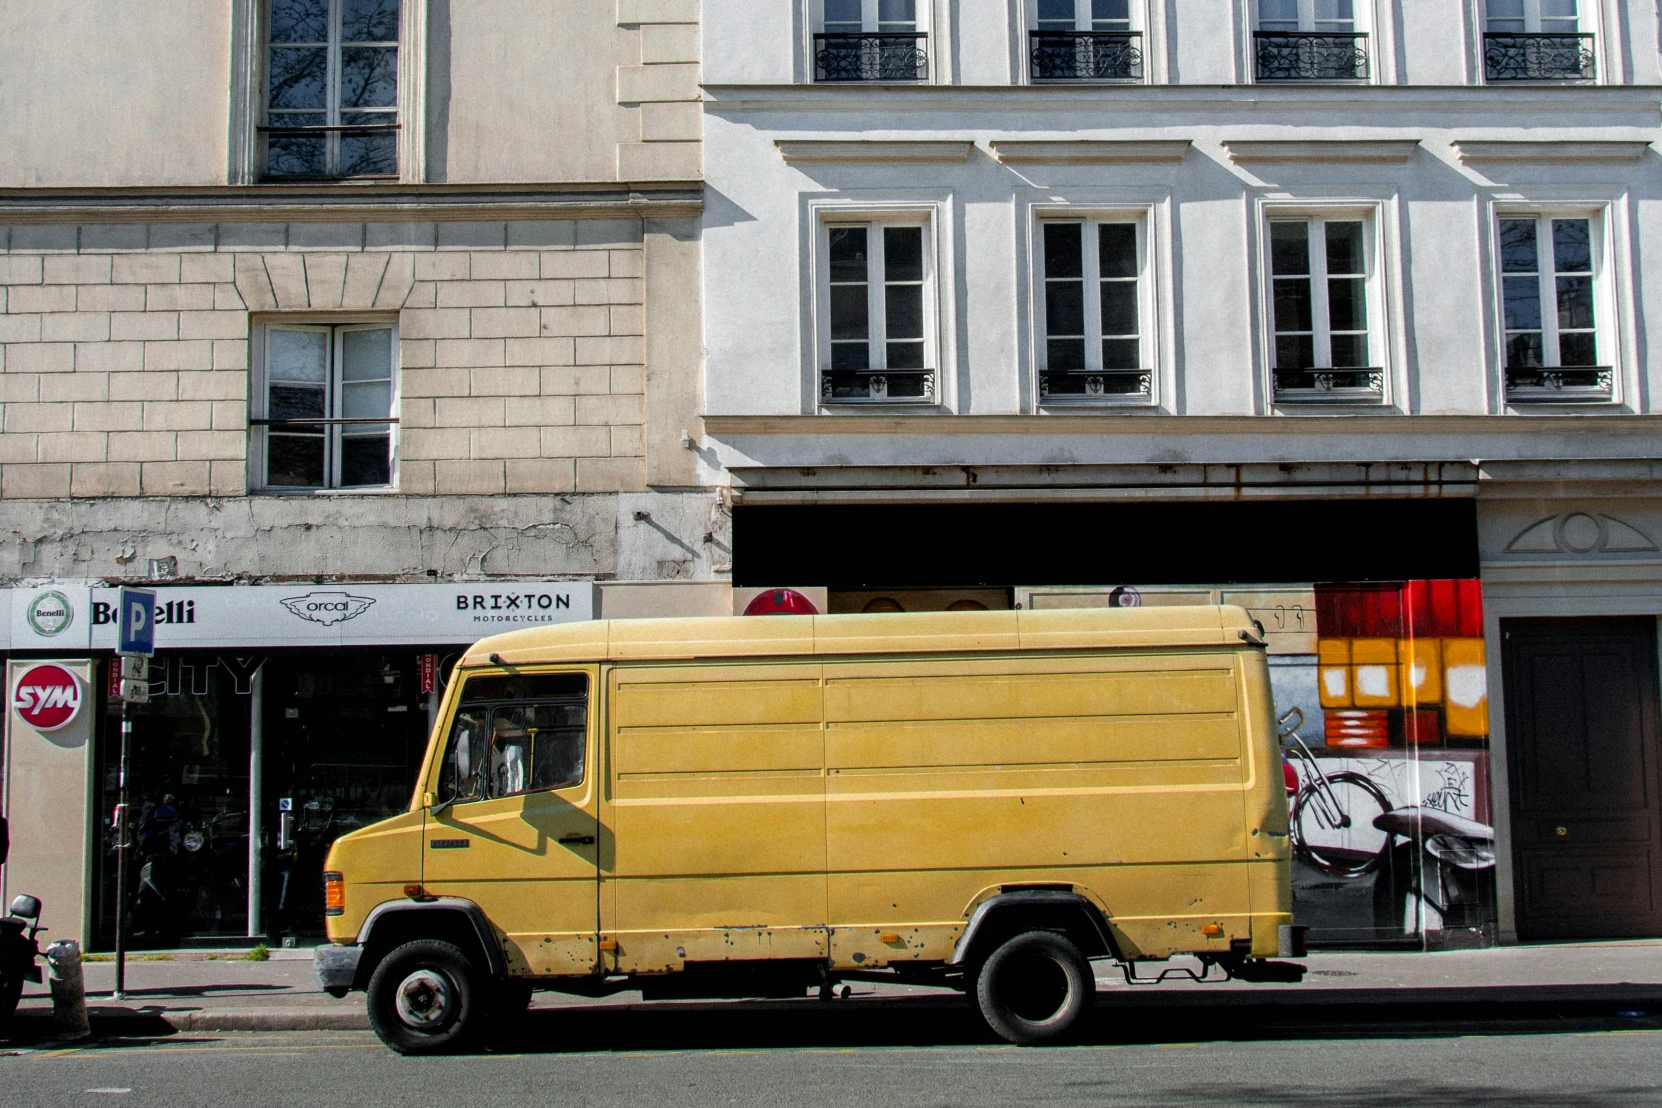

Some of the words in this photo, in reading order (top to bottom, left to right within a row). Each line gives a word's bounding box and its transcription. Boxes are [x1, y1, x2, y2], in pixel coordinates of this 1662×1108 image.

[306, 601, 349, 612] orcal
[456, 594, 570, 610] BRIXTON
[36, 609, 65, 617] Benelli
[473, 615, 553, 623] MOTORCYCLES
[130, 602, 146, 642] P
[13, 685, 78, 715] SYM
